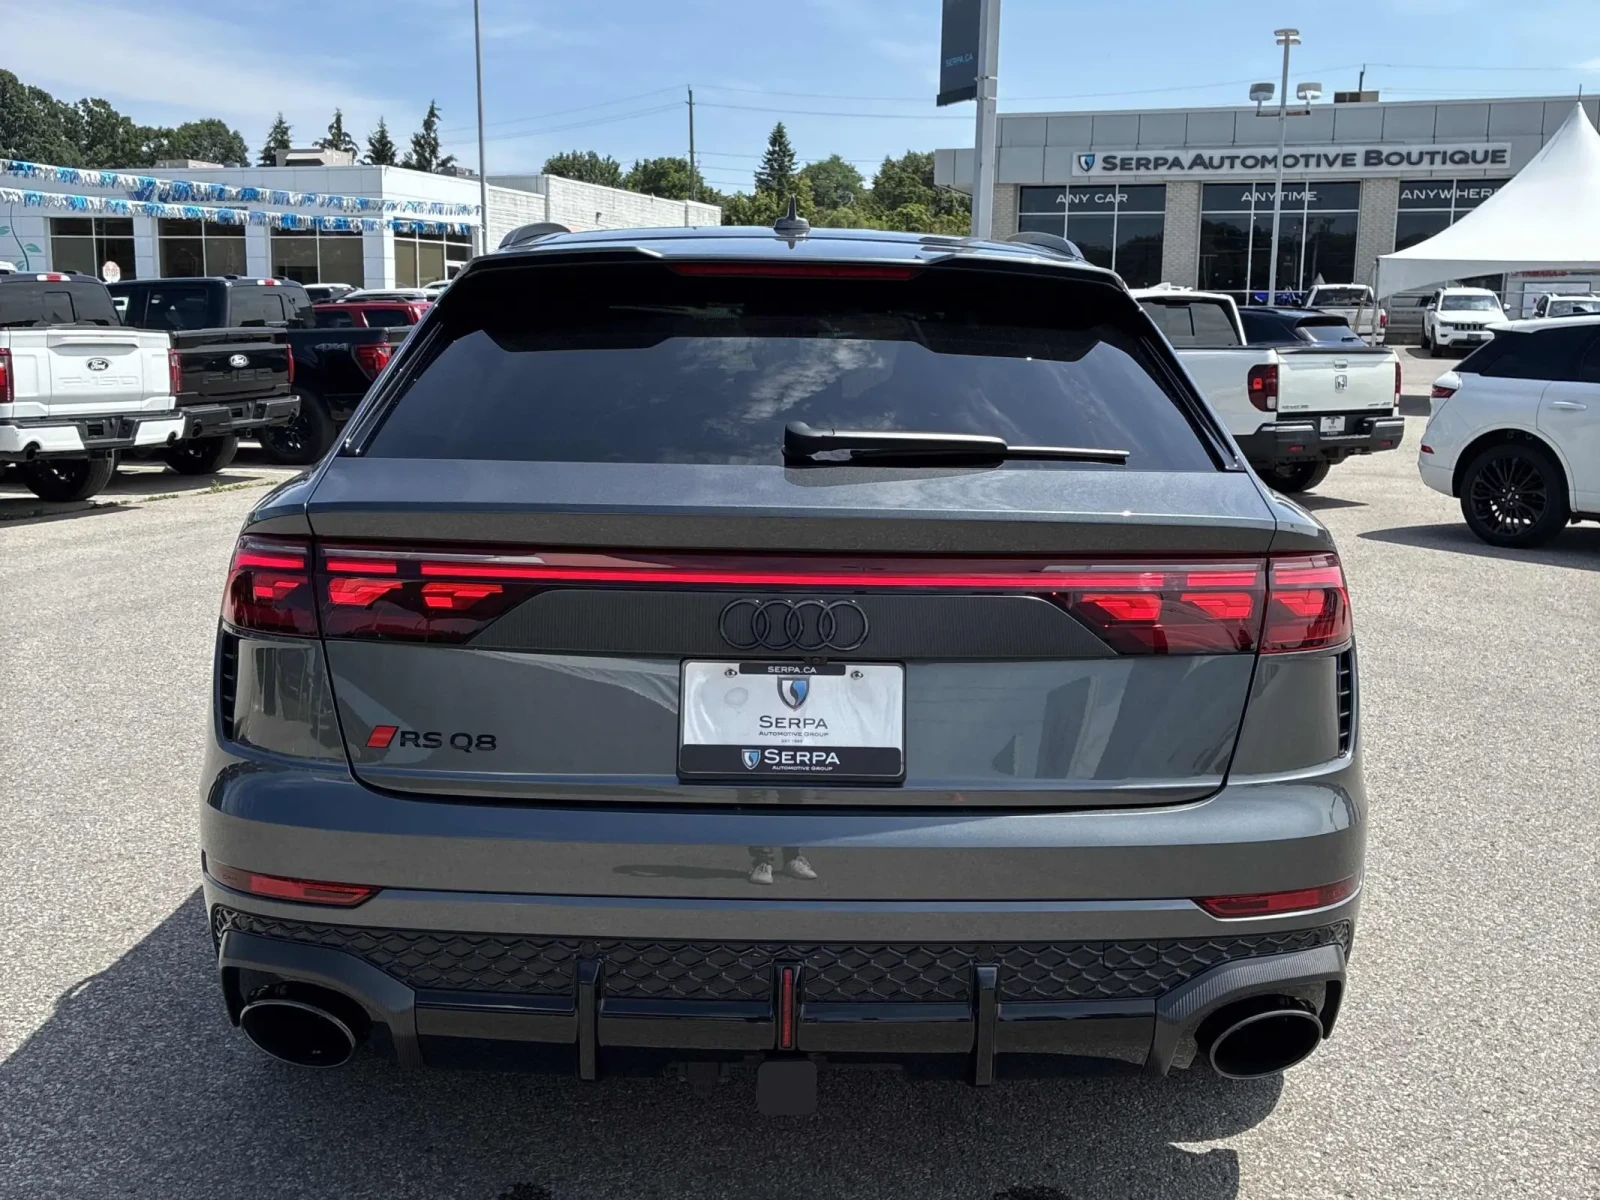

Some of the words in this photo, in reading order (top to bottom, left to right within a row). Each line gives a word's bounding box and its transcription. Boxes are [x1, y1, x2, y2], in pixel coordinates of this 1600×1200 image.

[1101, 154, 1185, 172] SERPA
[1187, 152, 1357, 171] AUTOMOTIVE
[1363, 149, 1508, 167] BOUTIQUE
[1055, 194, 1090, 204] ANY
[1094, 193, 1128, 204] CAR
[1241, 191, 1318, 202] ANYTIME
[767, 665, 818, 674] SERPA.CA
[758, 714, 829, 730] SERPA
[400, 730, 443, 749] RS
[449, 732, 497, 753] Q8
[764, 748, 841, 765] SERPA
